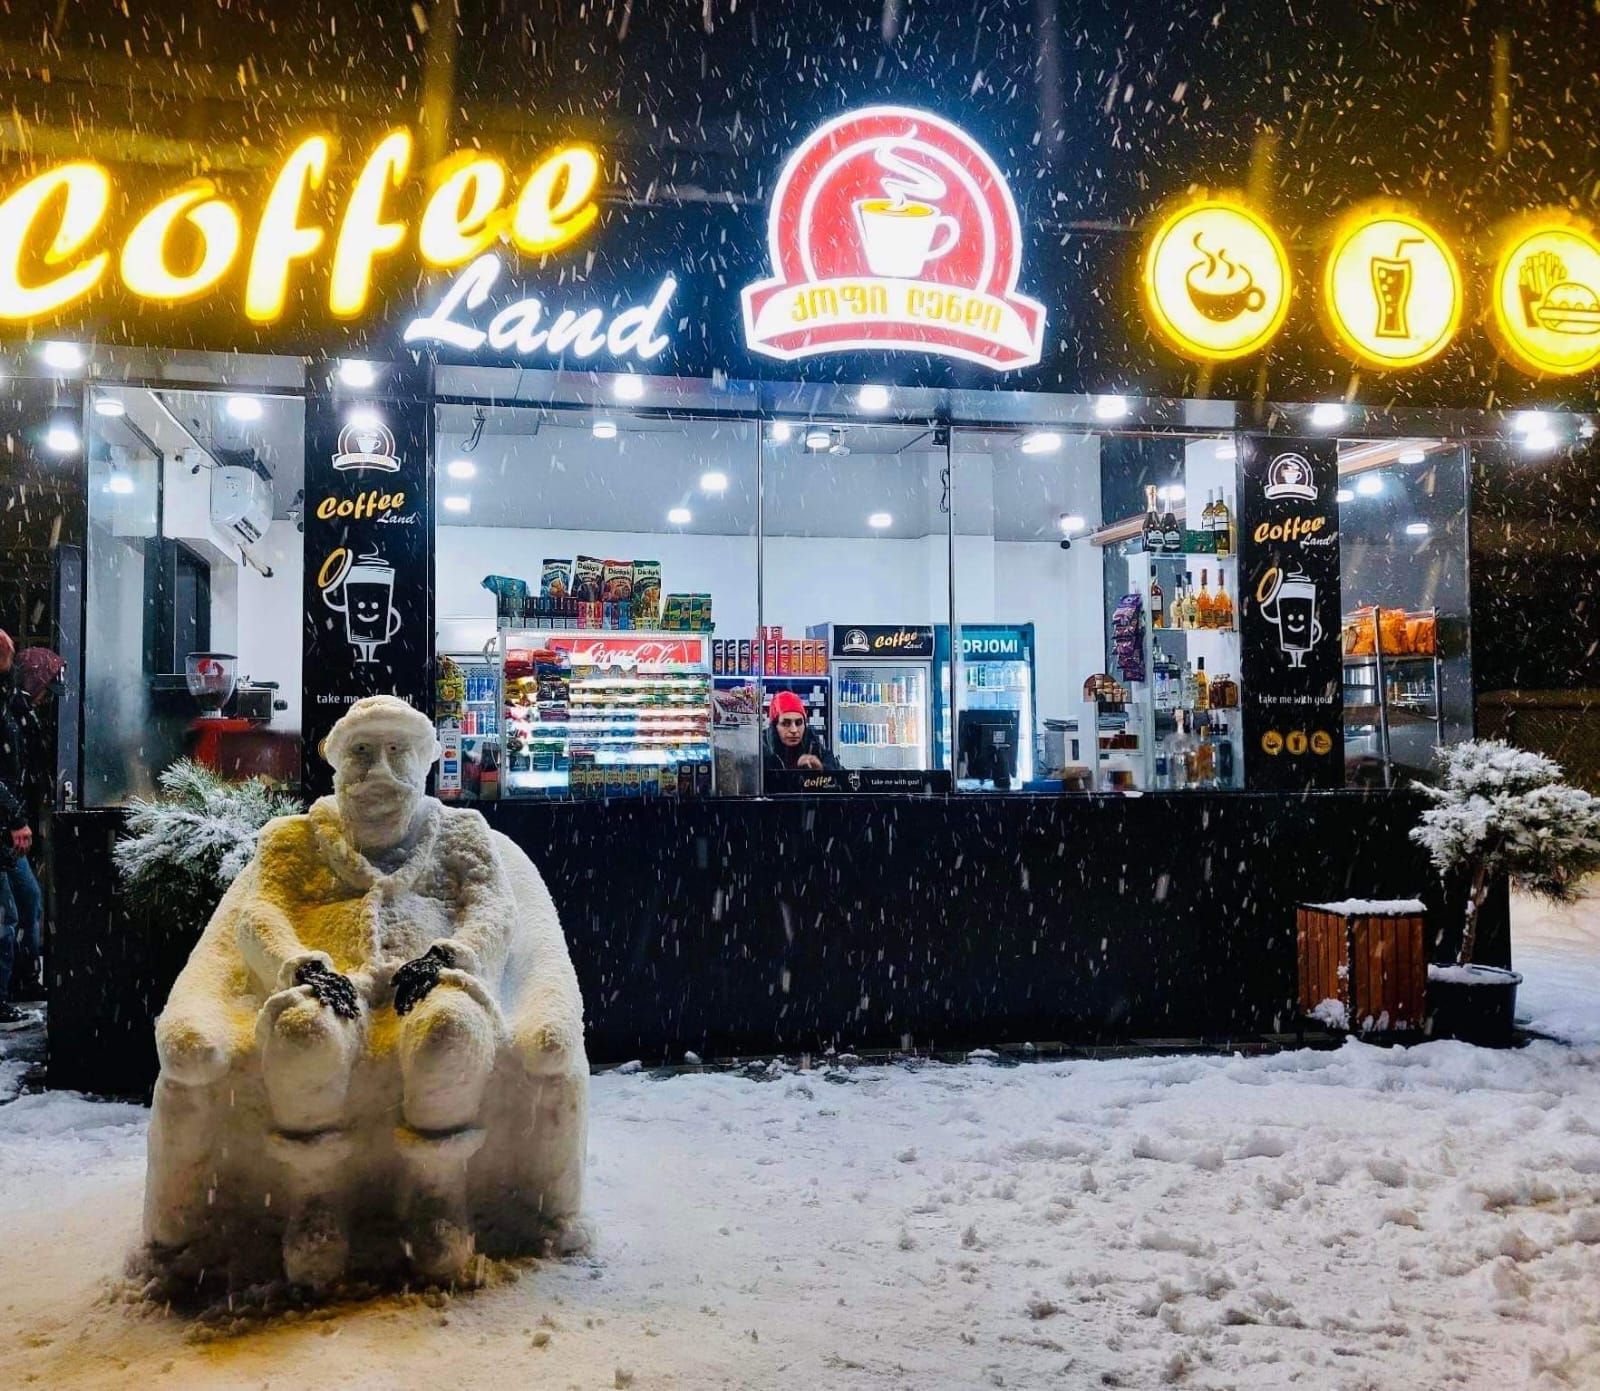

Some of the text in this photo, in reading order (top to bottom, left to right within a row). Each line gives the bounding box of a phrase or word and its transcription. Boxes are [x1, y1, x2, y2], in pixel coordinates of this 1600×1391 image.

[0, 127, 600, 322] Coffee
[403, 253, 678, 359] Land
[316, 490, 406, 520] Coffee
[376, 509, 417, 525] Land
[1254, 516, 1326, 543] Coffee
[1300, 532, 1333, 546] Land
[874, 630, 918, 648] Coffee
[316, 693, 340, 704] take
[1258, 693, 1278, 704] take
[1280, 696, 1292, 704] me
[1294, 695, 1313, 705] with
[803, 776, 832, 788] Coffee
